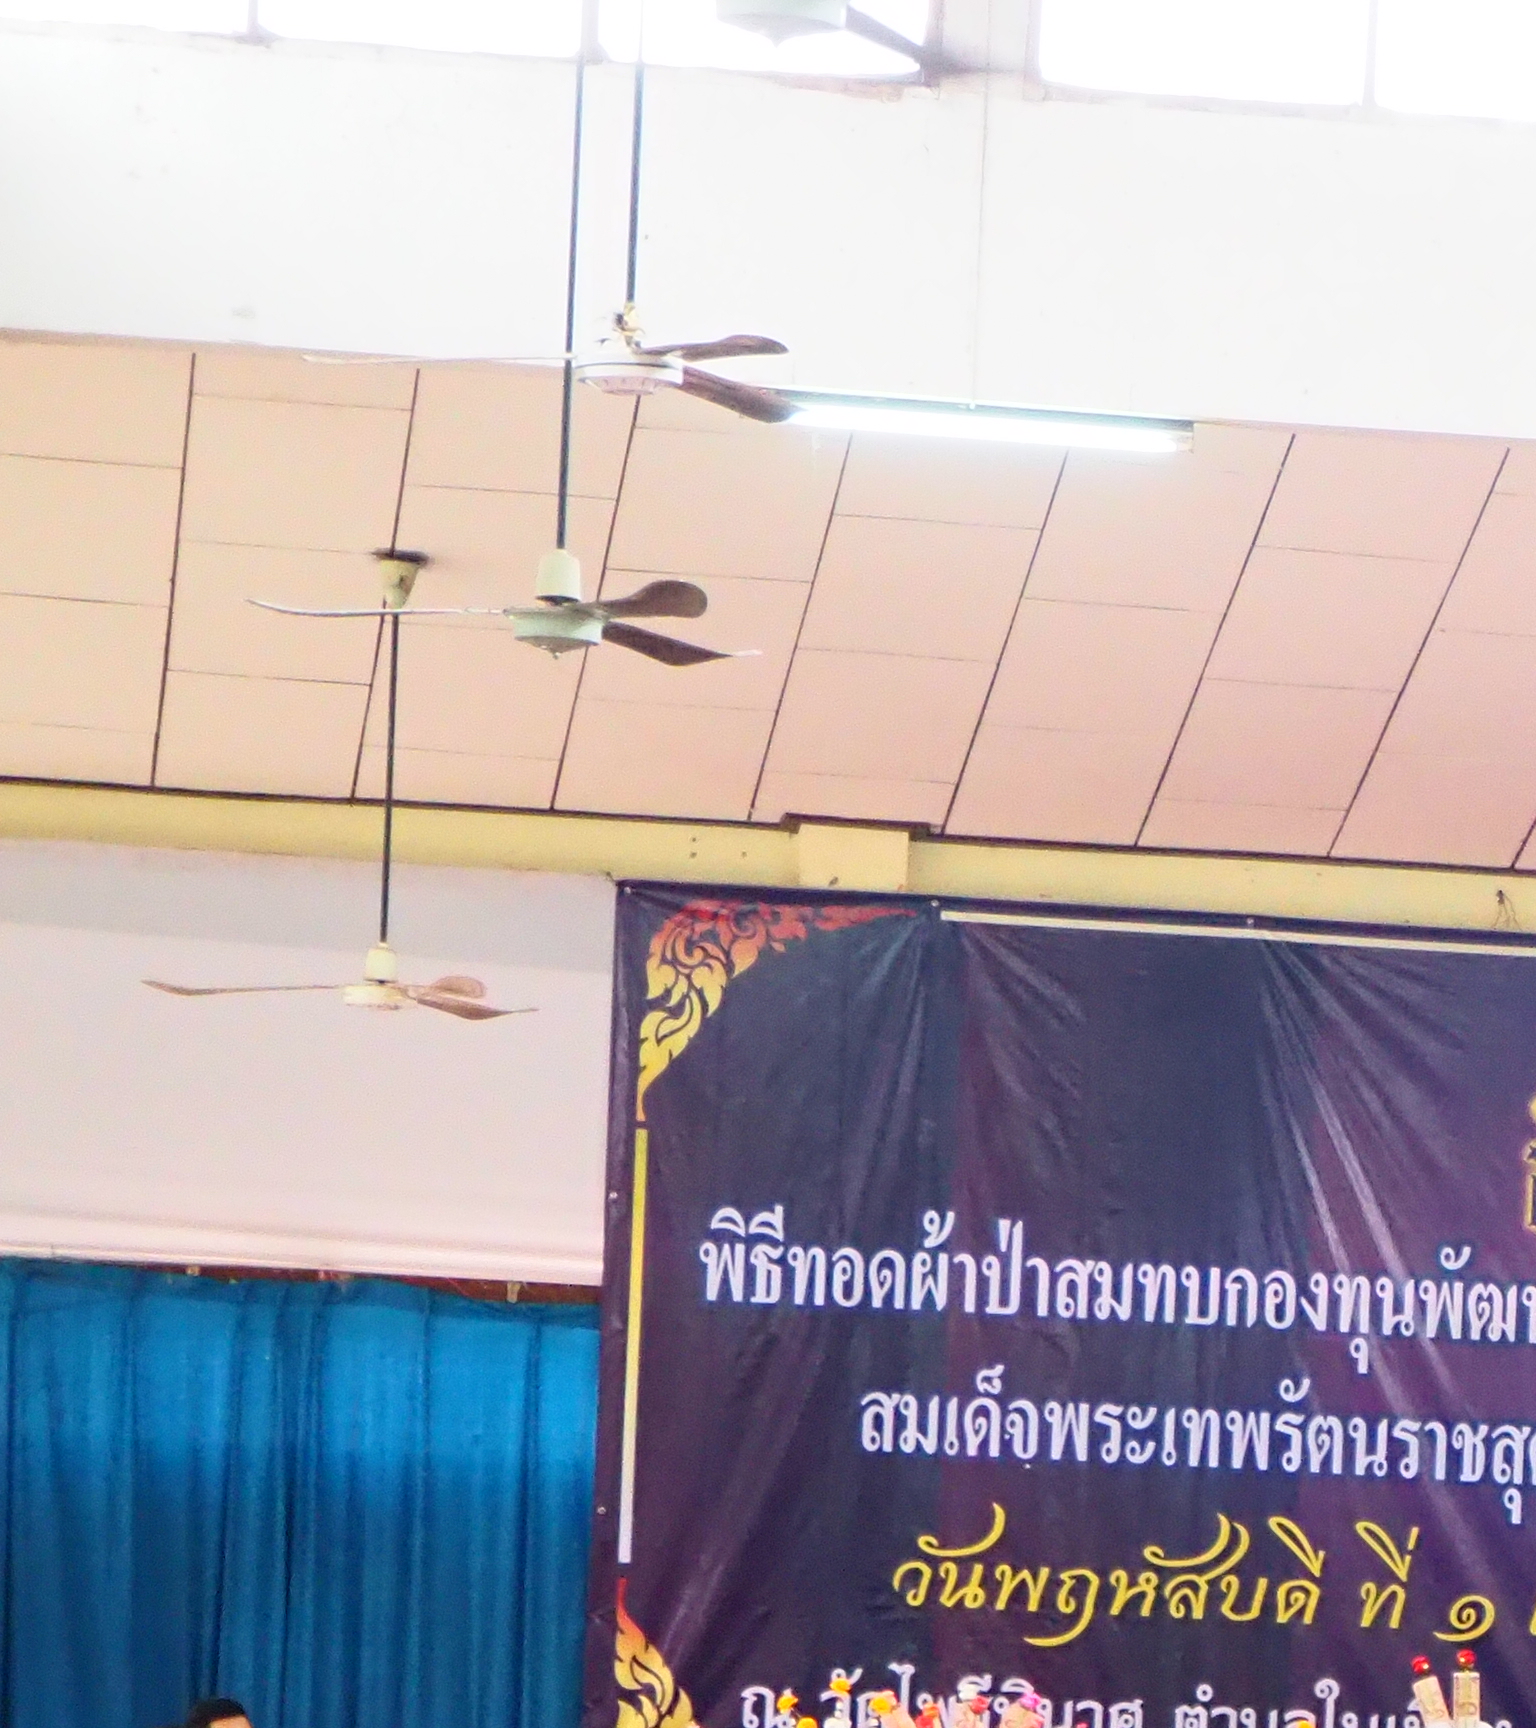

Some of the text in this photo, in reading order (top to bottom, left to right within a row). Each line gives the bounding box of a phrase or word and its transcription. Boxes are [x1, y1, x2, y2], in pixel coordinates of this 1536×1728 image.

[891, 1502, 1325, 1647] วันพฤหัสบดี
[1355, 1518, 1420, 1630] ที่
[1434, 1594, 1496, 1642] ๑
